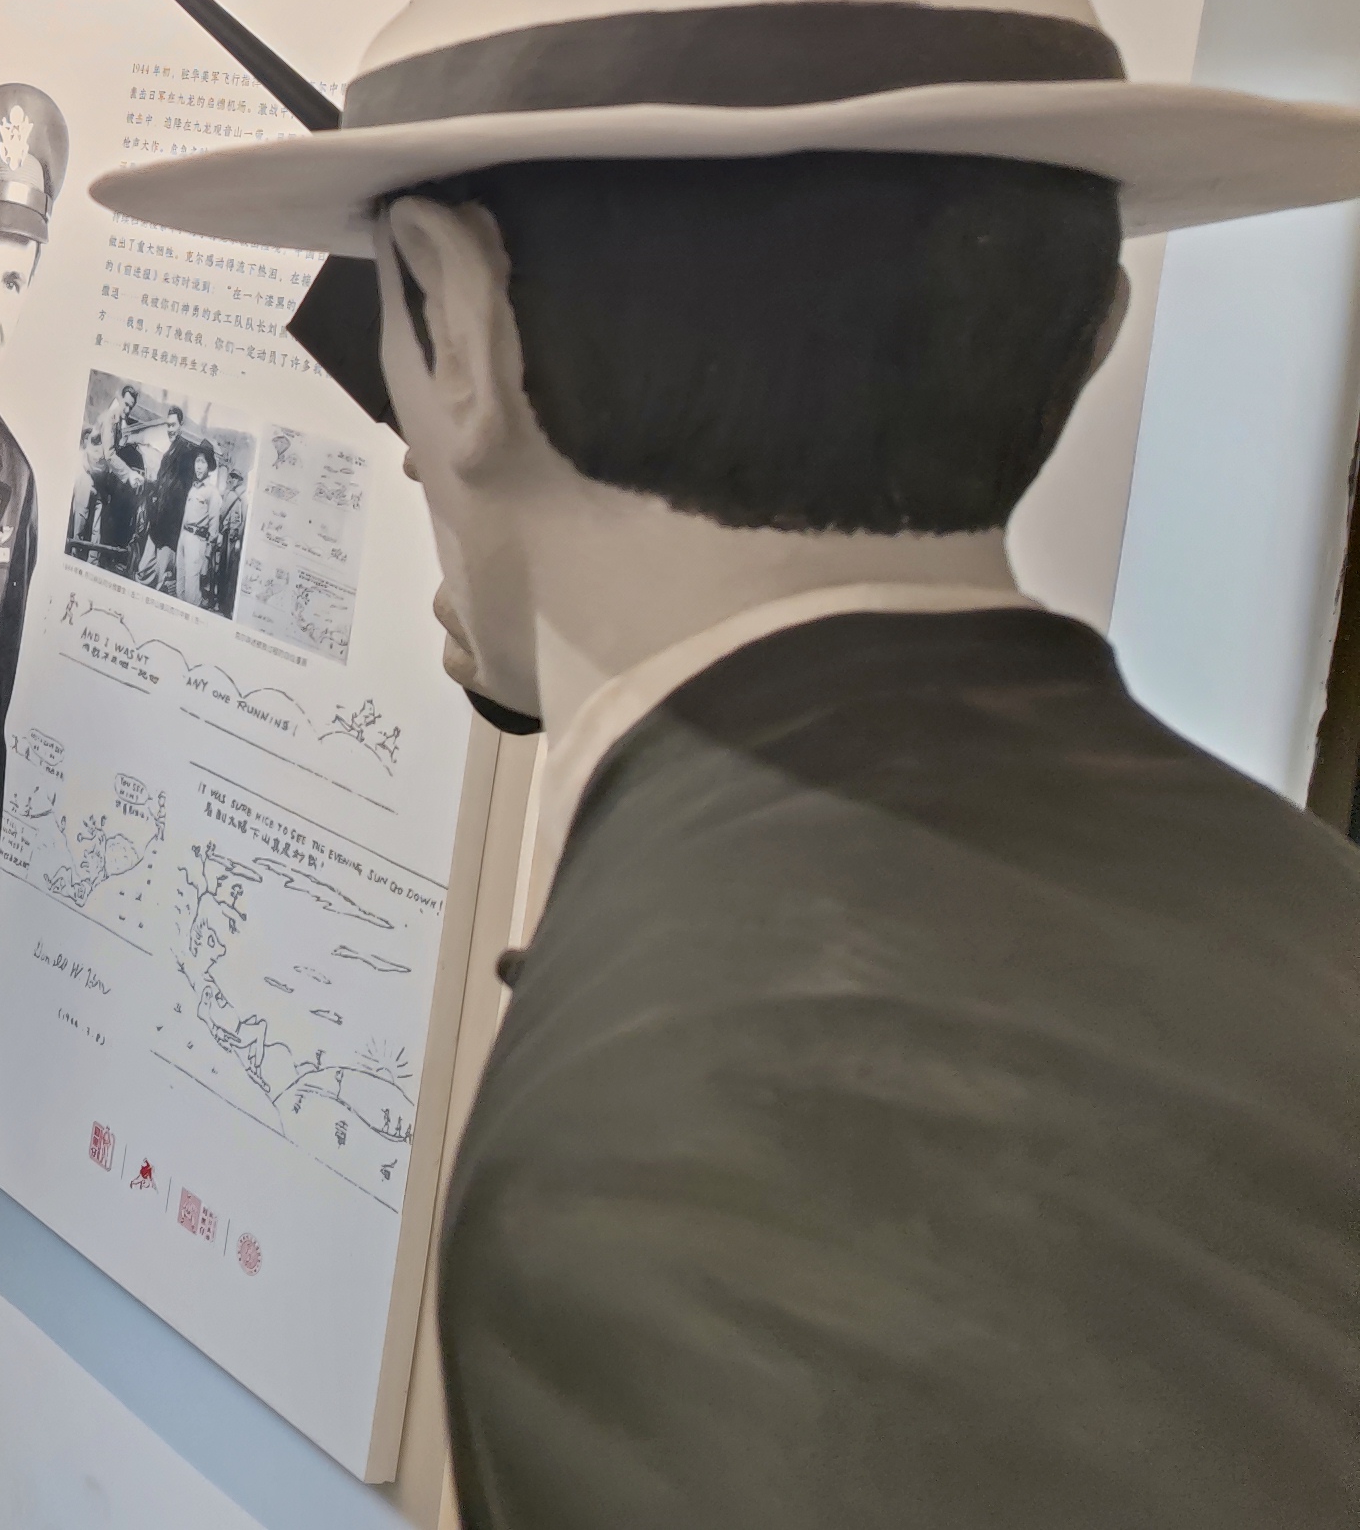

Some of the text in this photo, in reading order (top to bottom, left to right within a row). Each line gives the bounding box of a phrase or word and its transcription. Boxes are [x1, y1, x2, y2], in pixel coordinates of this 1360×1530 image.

[81, 627, 100, 643] AND
[104, 637, 109, 648] I
[186, 677, 208, 692] ANY
[212, 690, 231, 704] ONE
[198, 782, 206, 794] IT
[231, 799, 252, 817] SURE
[255, 810, 274, 828] NICE
[277, 823, 289, 836] TO
[290, 829, 307, 845] SEE
[311, 840, 326, 854] THE
[328, 850, 363, 876] EVENING
[367, 869, 388, 885] SUN
